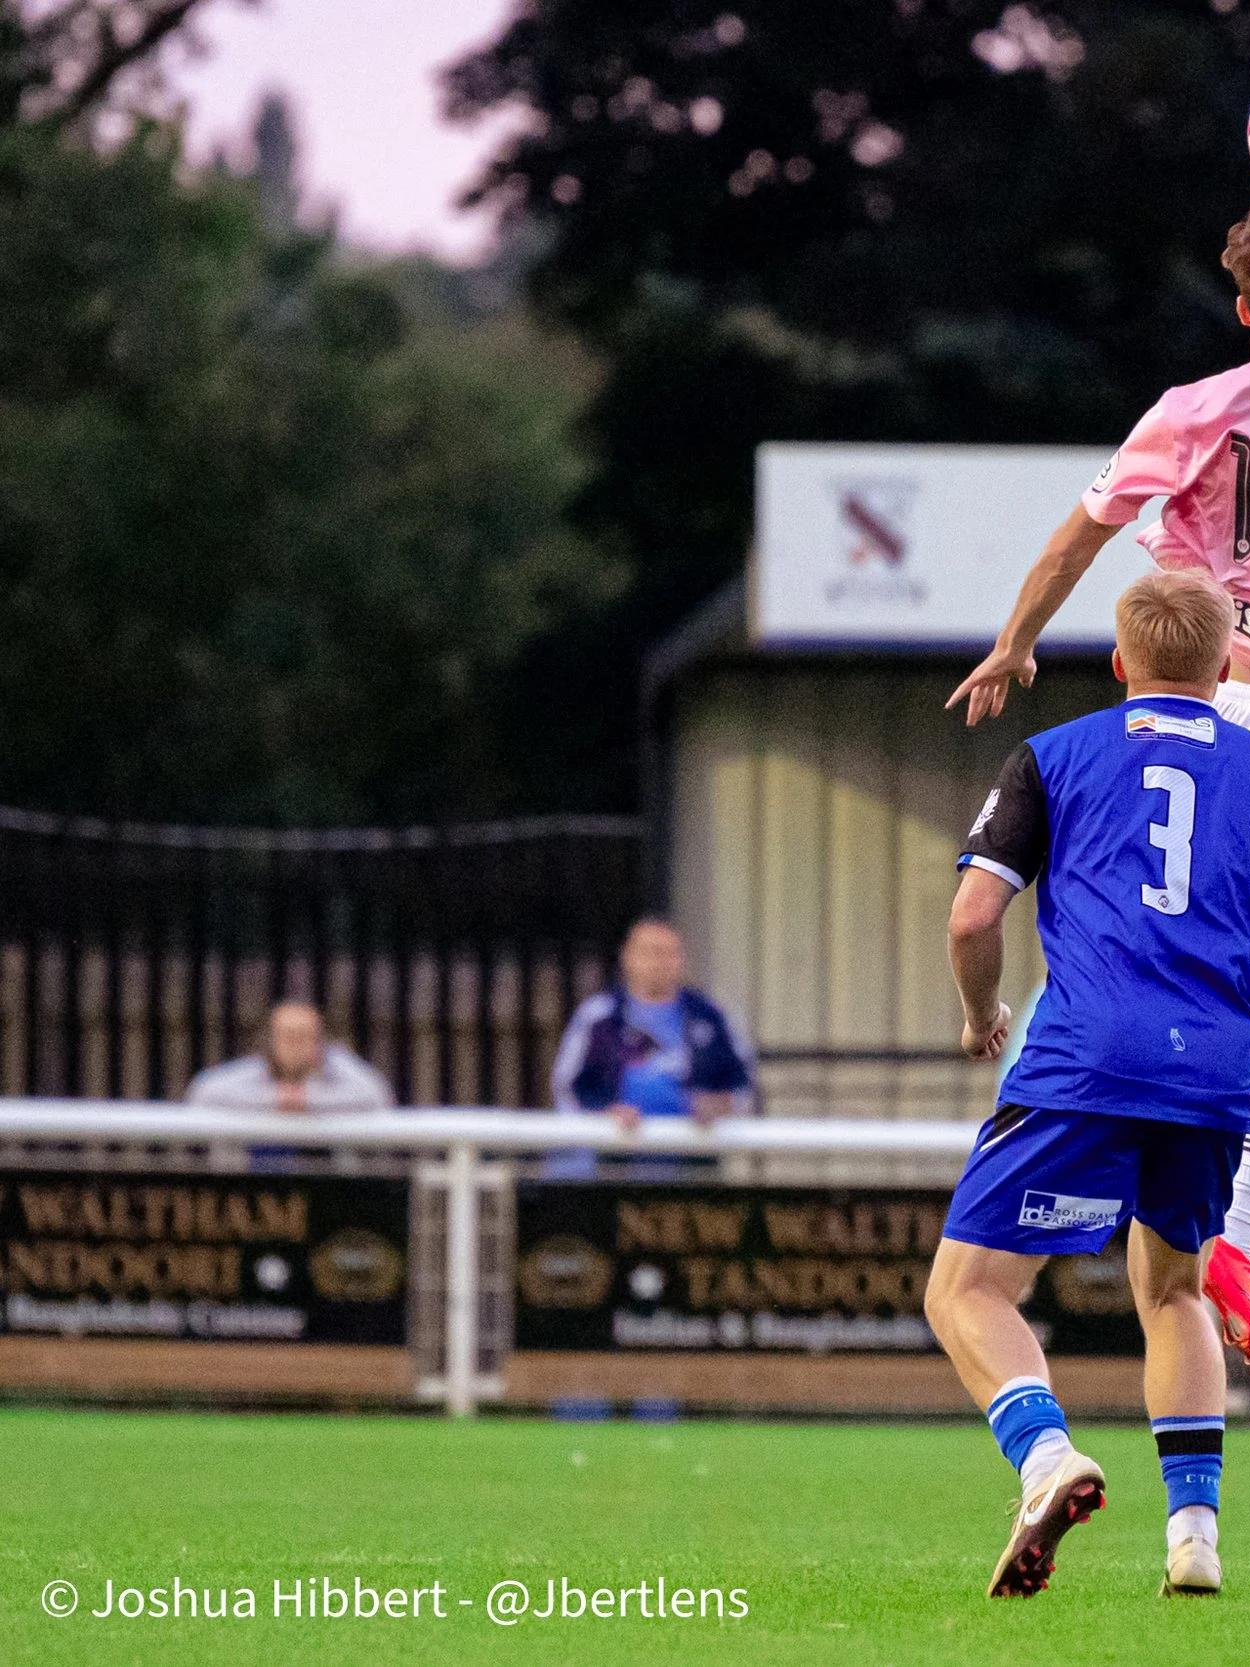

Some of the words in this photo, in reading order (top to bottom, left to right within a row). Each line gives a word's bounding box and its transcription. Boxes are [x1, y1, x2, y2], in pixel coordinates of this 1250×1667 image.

[1142, 765, 1197, 916] 3
[1054, 1208, 1084, 1219] ROSS
[2, 1242, 242, 1293] NDOORI
